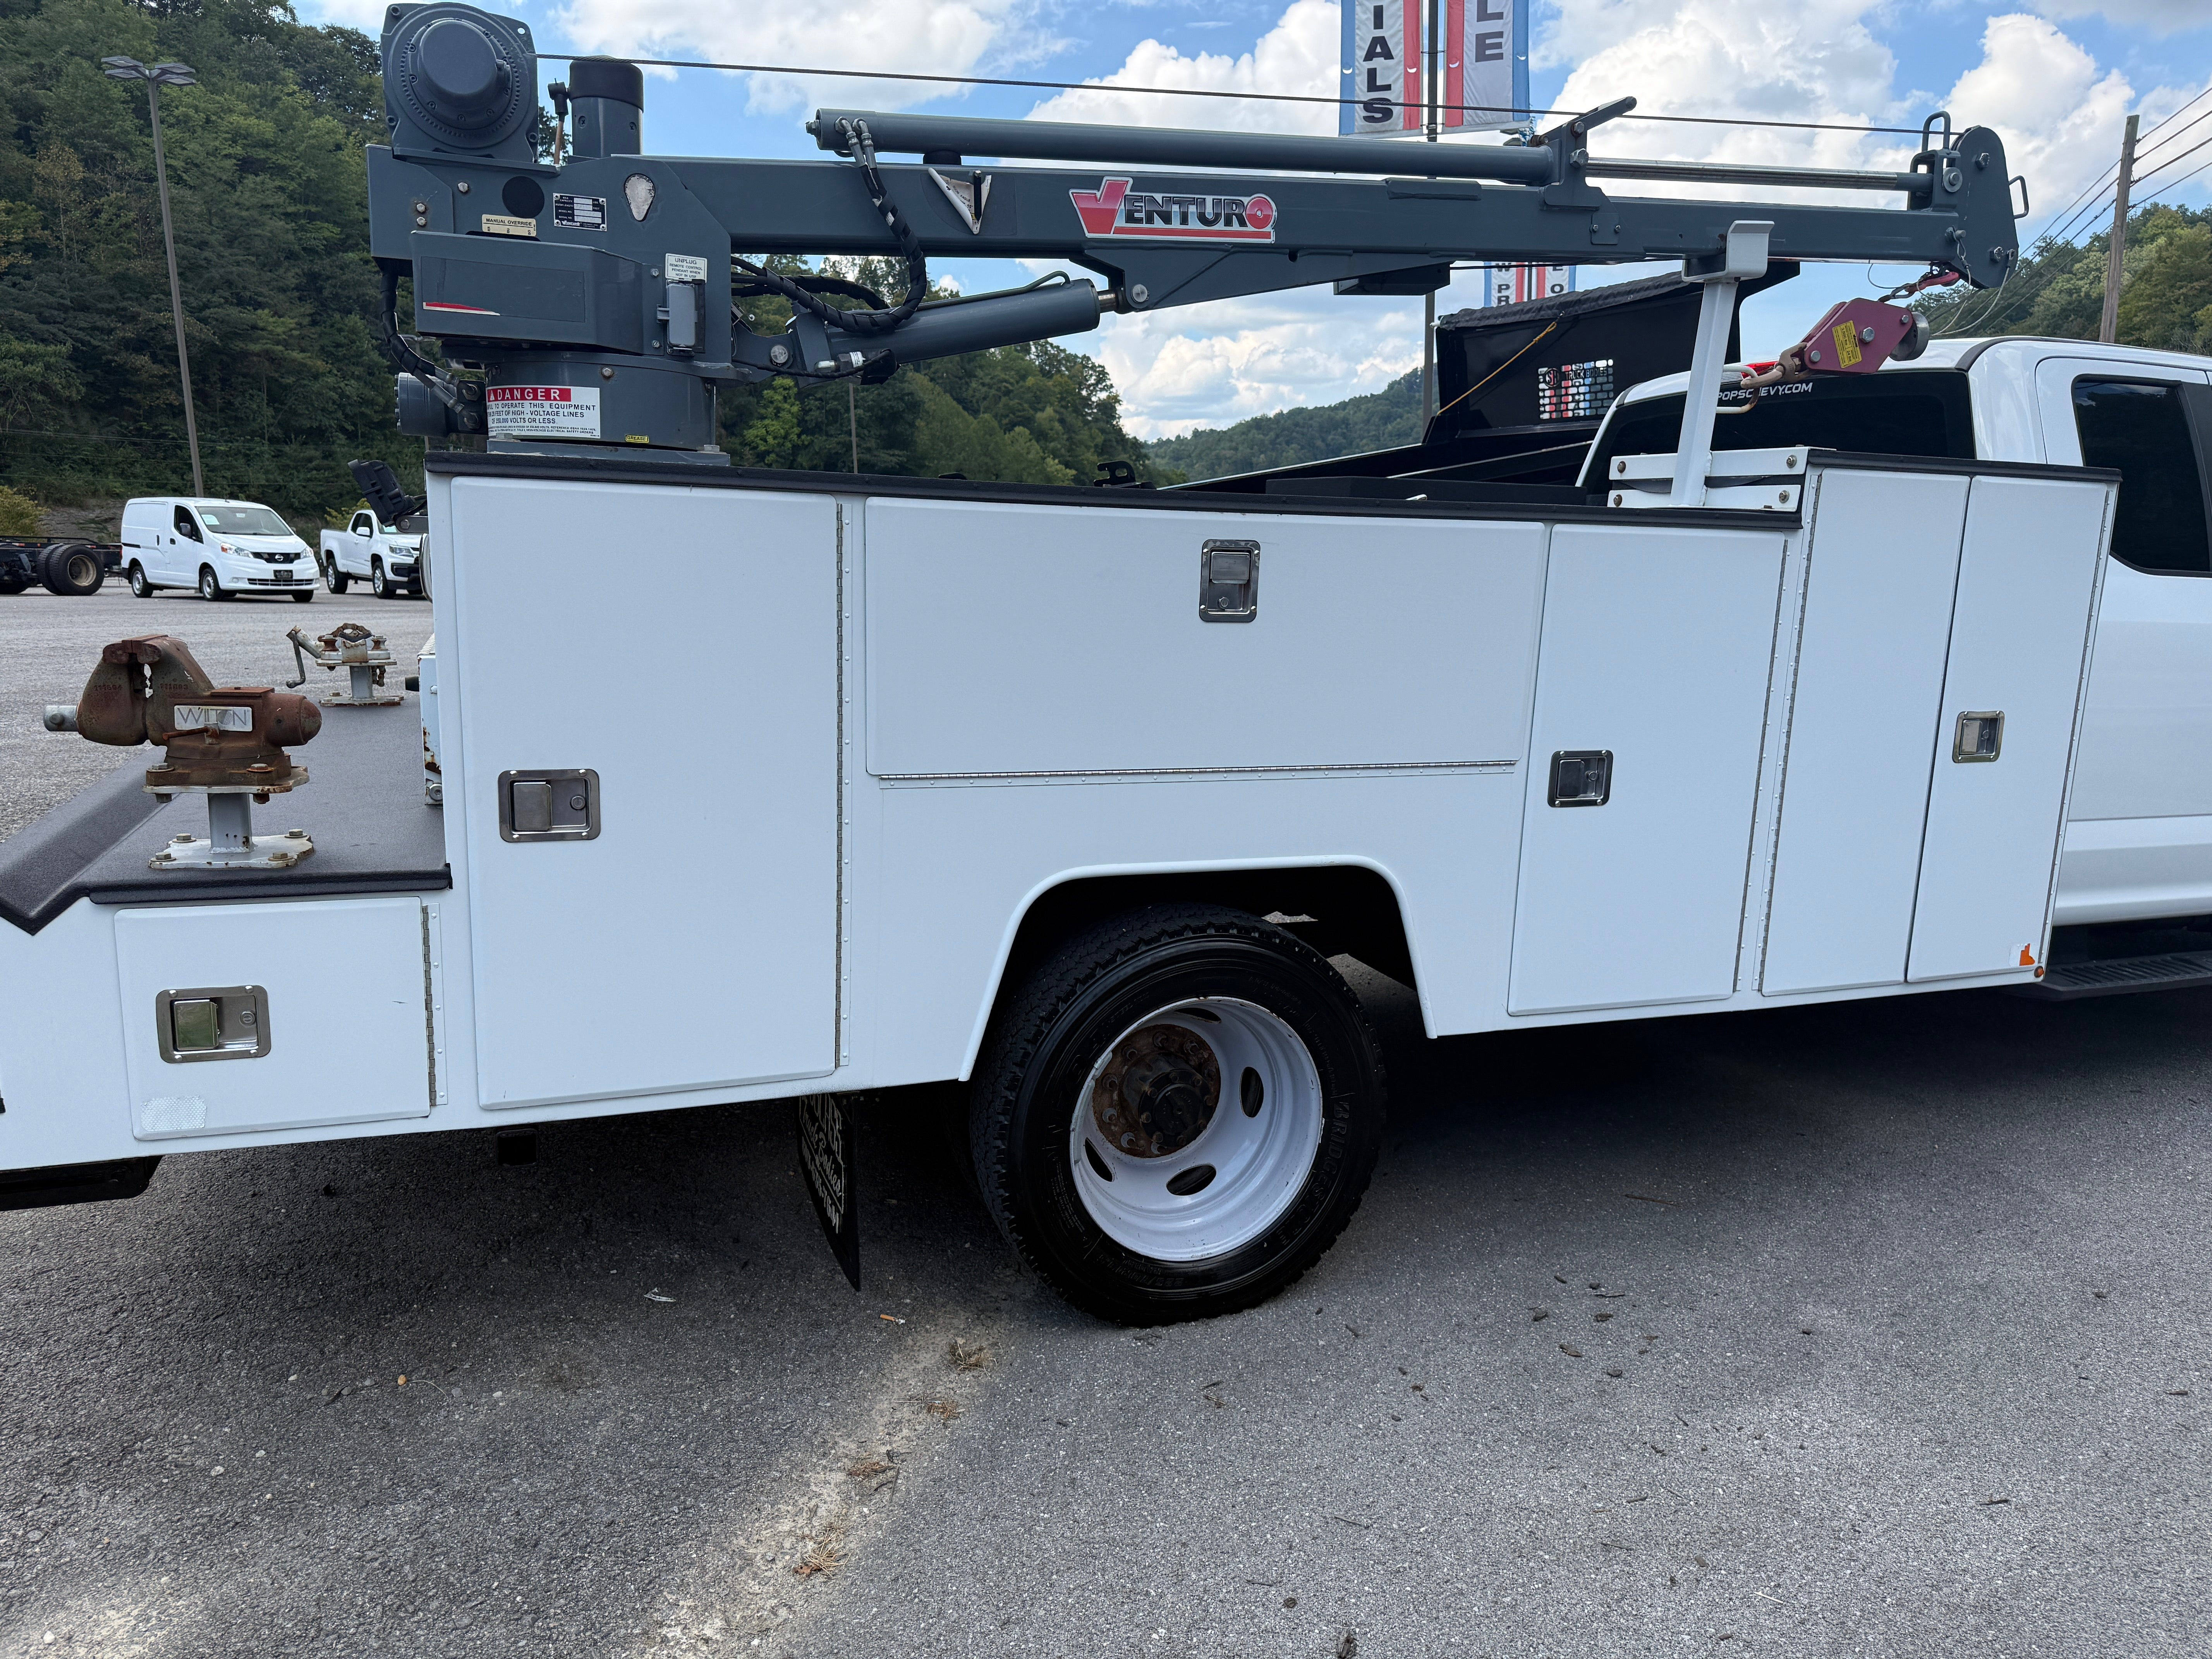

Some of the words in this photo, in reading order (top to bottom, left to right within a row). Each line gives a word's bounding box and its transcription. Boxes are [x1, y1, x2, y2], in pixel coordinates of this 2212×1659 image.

[1071, 180, 1274, 235] VENTURO
[1565, 370, 1584, 380] TRUCK
[1585, 367, 1607, 378] BODIES
[497, 388, 560, 400] DANGER
[1718, 382, 1813, 400] OPSCEVY.COM
[1277, 1102, 1350, 1245] BRIDGESTONE
